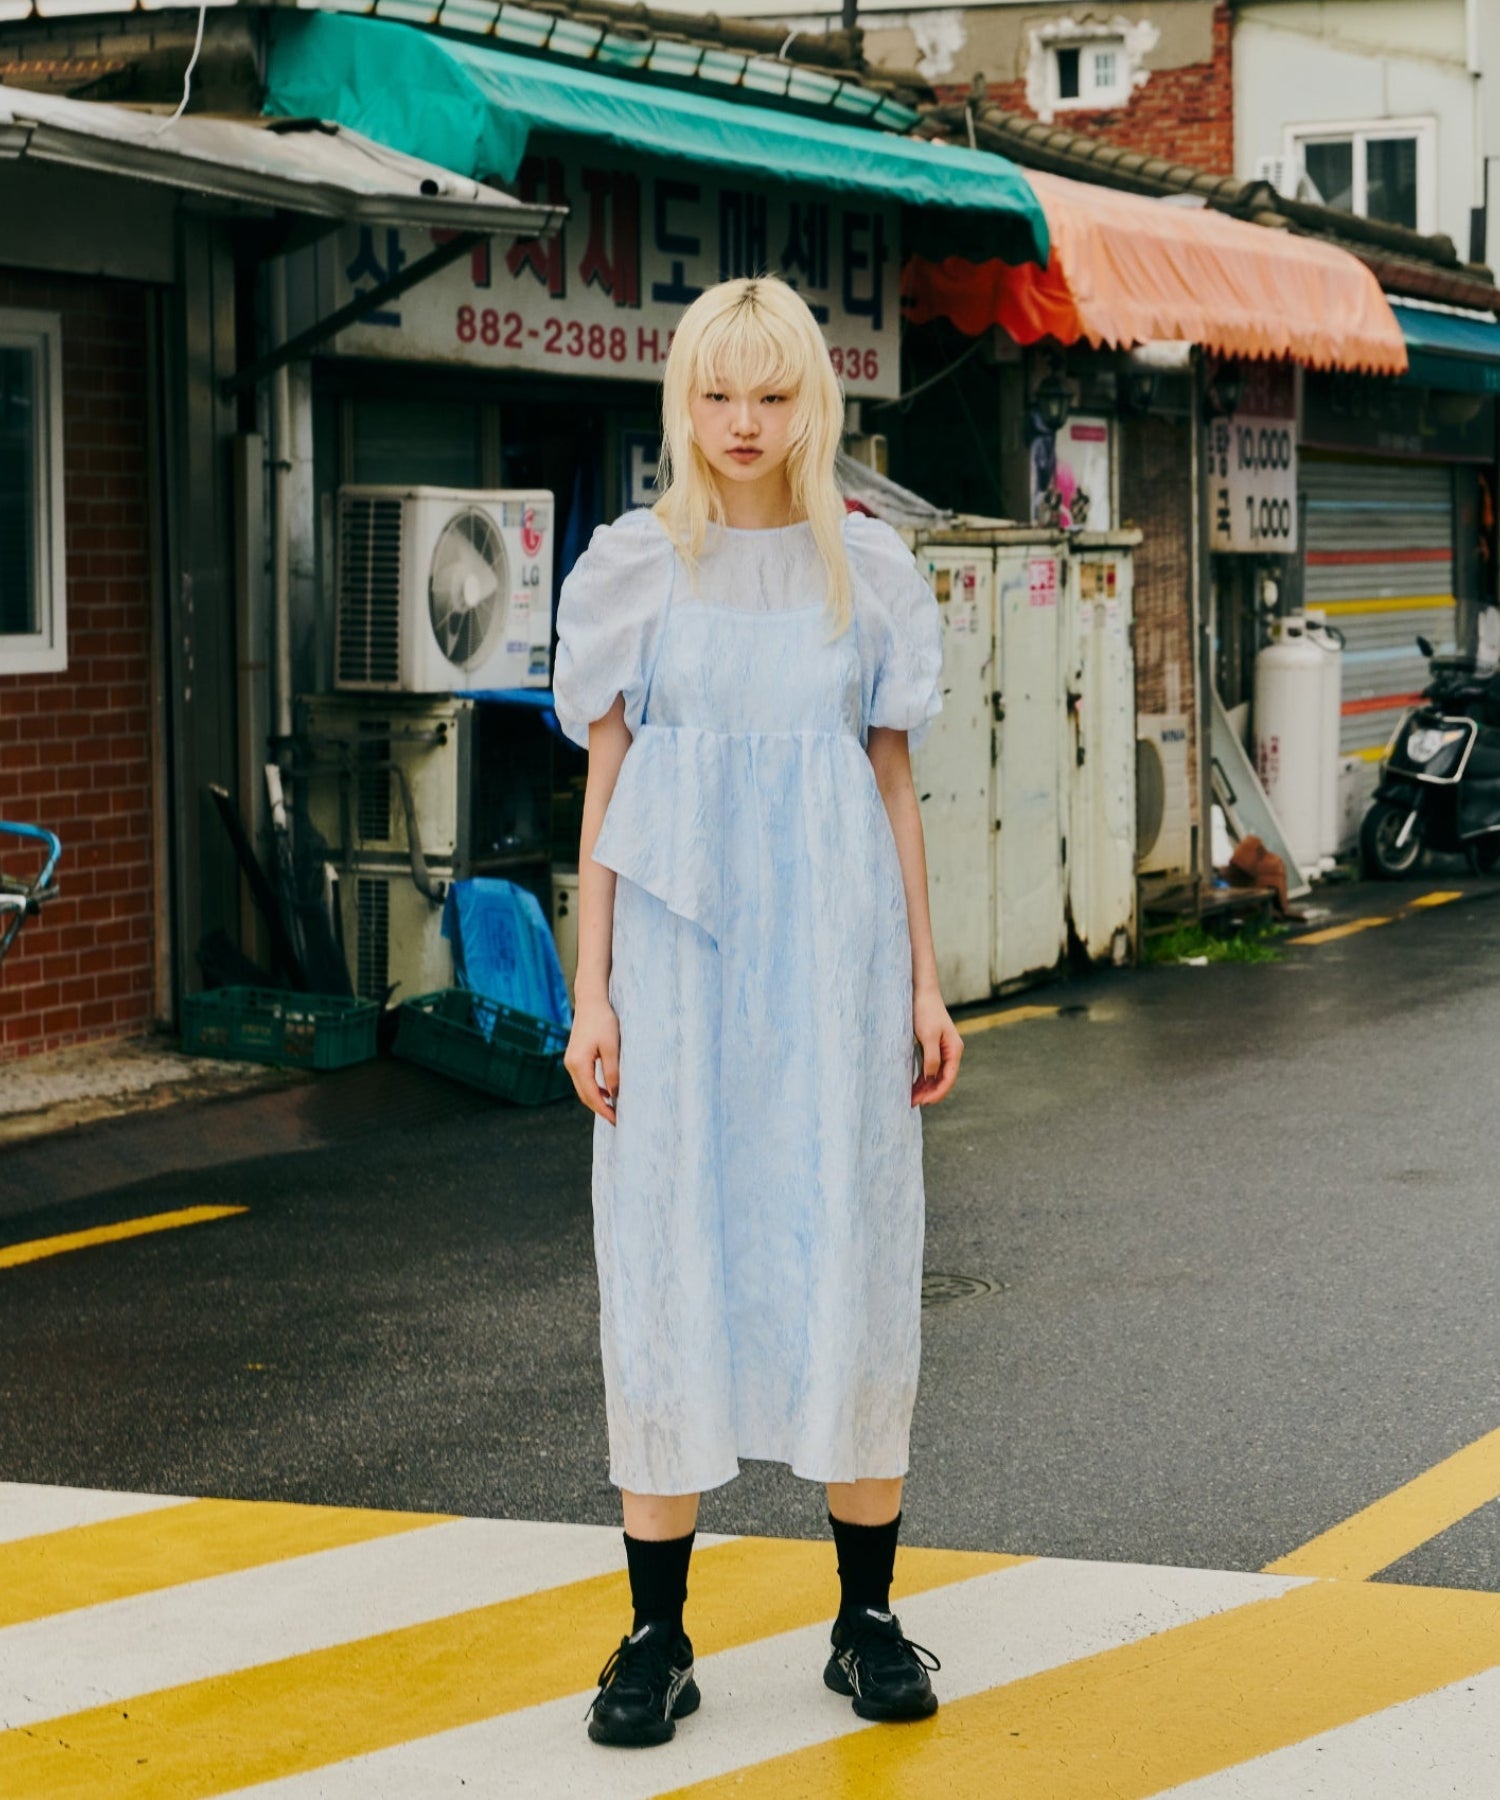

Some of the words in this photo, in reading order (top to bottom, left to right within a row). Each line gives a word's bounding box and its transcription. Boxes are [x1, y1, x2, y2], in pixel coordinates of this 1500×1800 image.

[456, 305, 627, 362] 882-2388
[1236, 425, 1291, 474] 10,000
[1246, 495, 1291, 545] 1,000
[522, 565, 540, 587] LG
